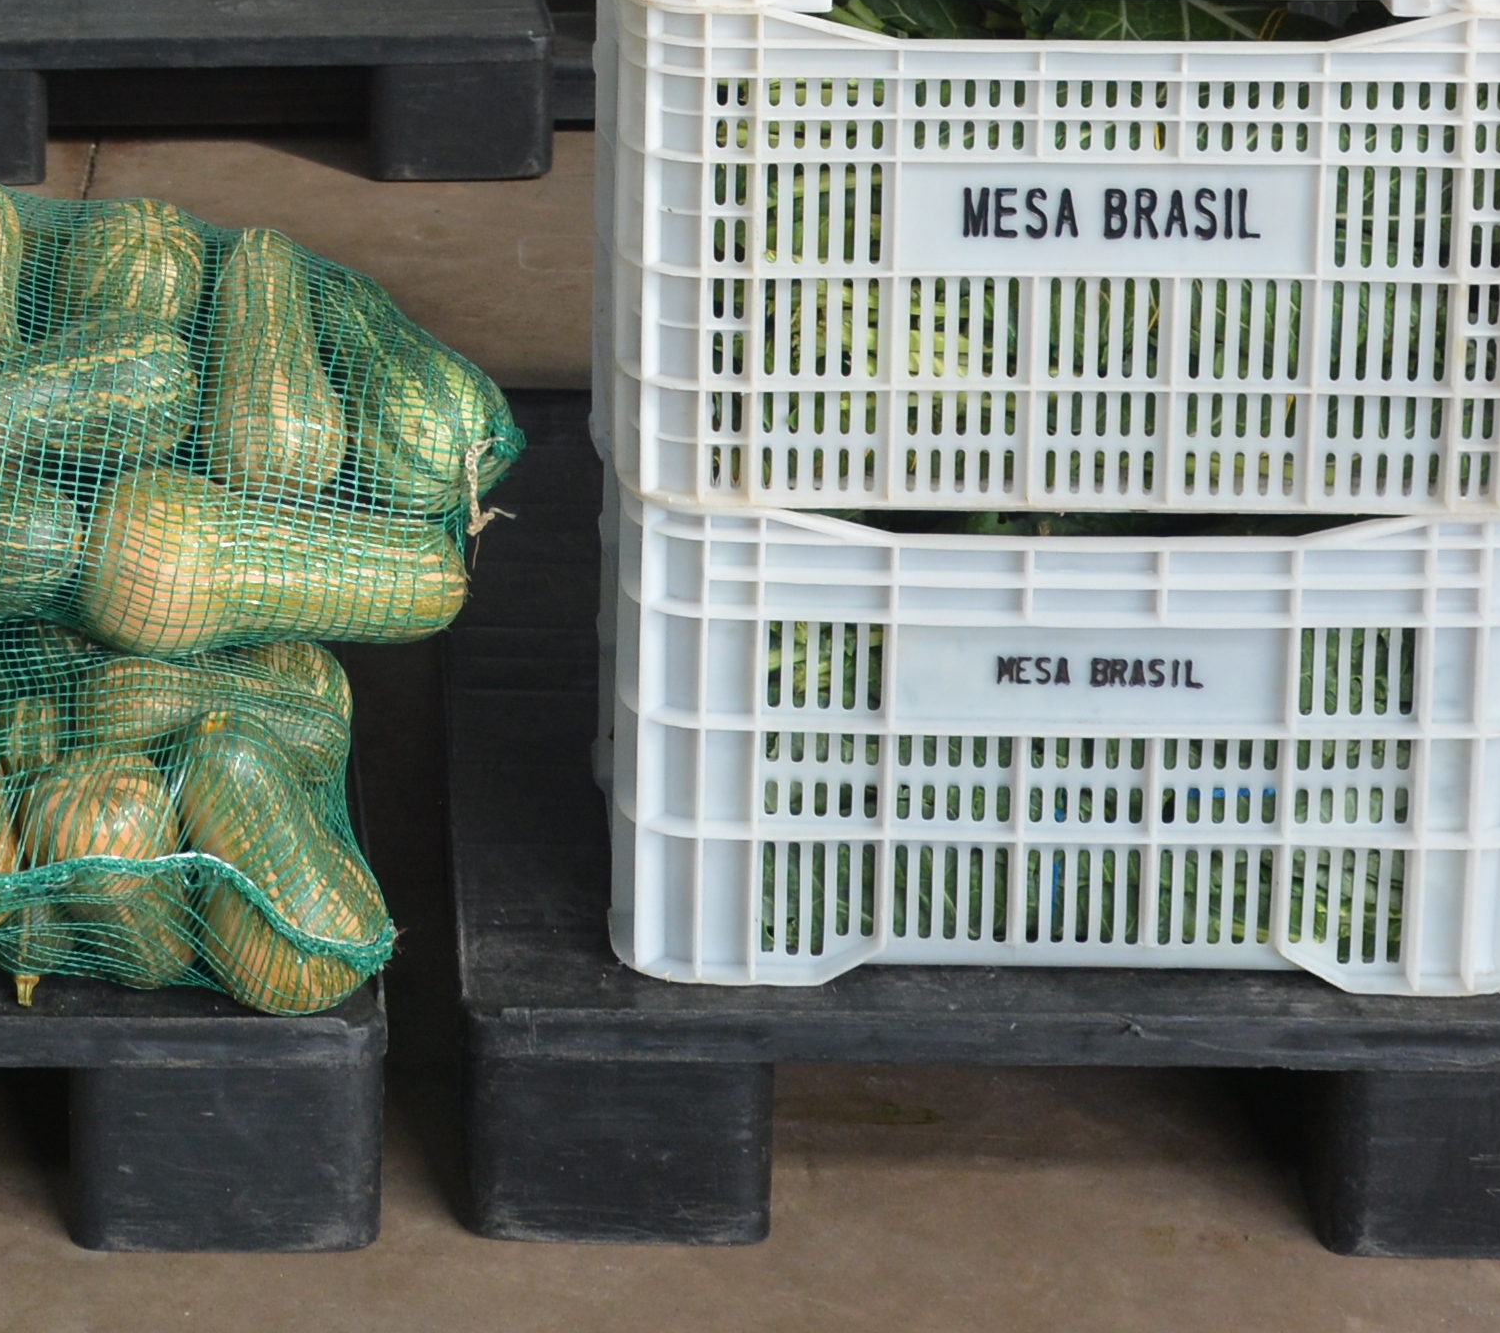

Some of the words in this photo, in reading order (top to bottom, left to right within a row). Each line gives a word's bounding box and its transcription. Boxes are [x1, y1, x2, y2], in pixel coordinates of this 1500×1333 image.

[962, 186, 1079, 240] MESA
[1103, 187, 1261, 241] BRASIL
[996, 655, 1071, 686] MESA
[1089, 657, 1204, 690] BRASIL
